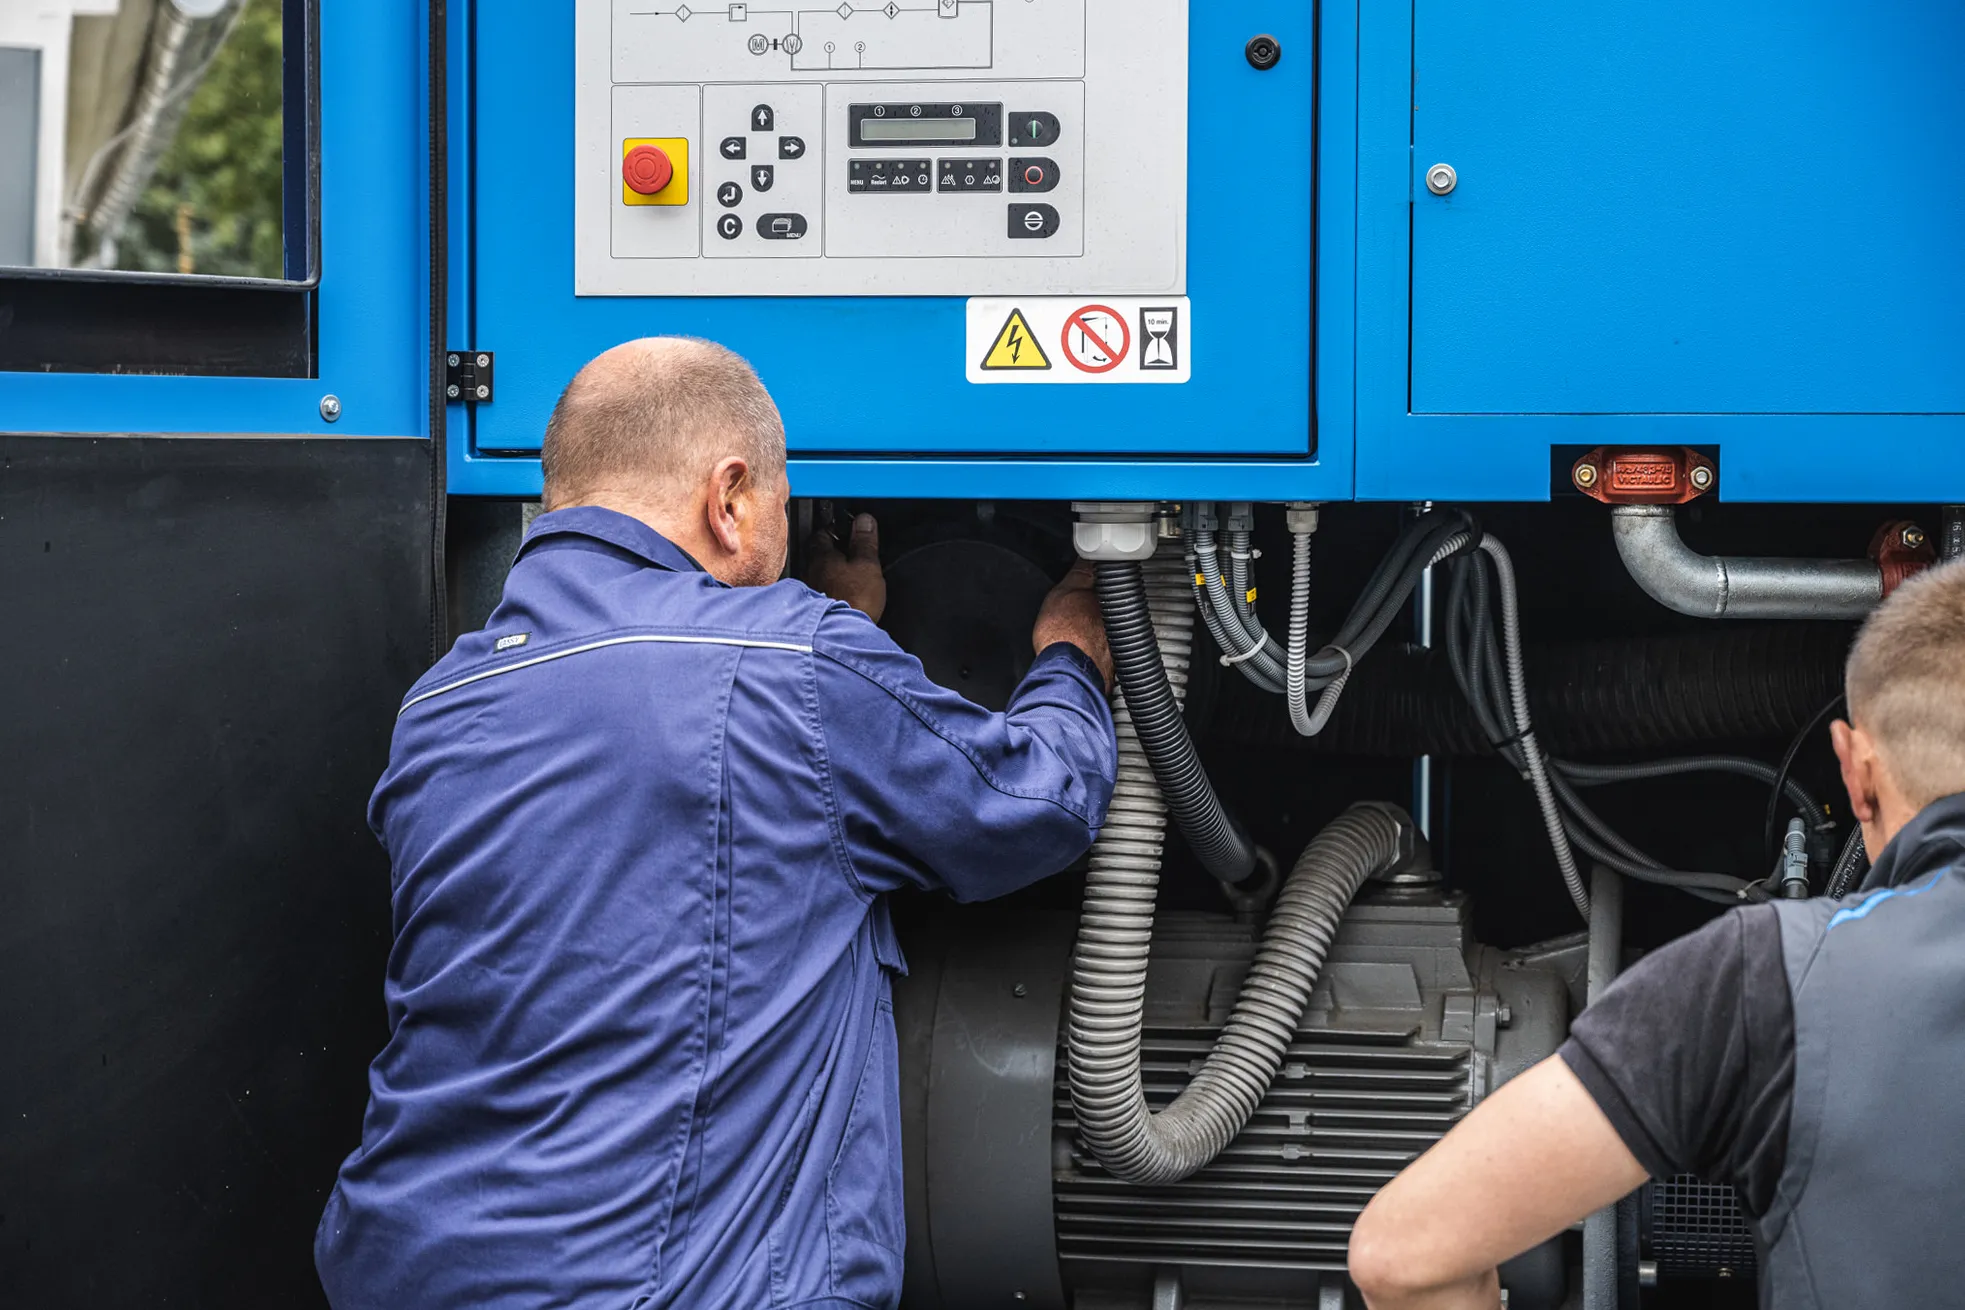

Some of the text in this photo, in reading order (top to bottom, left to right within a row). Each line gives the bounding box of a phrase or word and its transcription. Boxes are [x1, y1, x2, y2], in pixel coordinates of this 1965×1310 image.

[723, 218, 736, 235] C
[1156, 317, 1169, 325] min.
[1617, 474, 1671, 485] VICTAULIC
